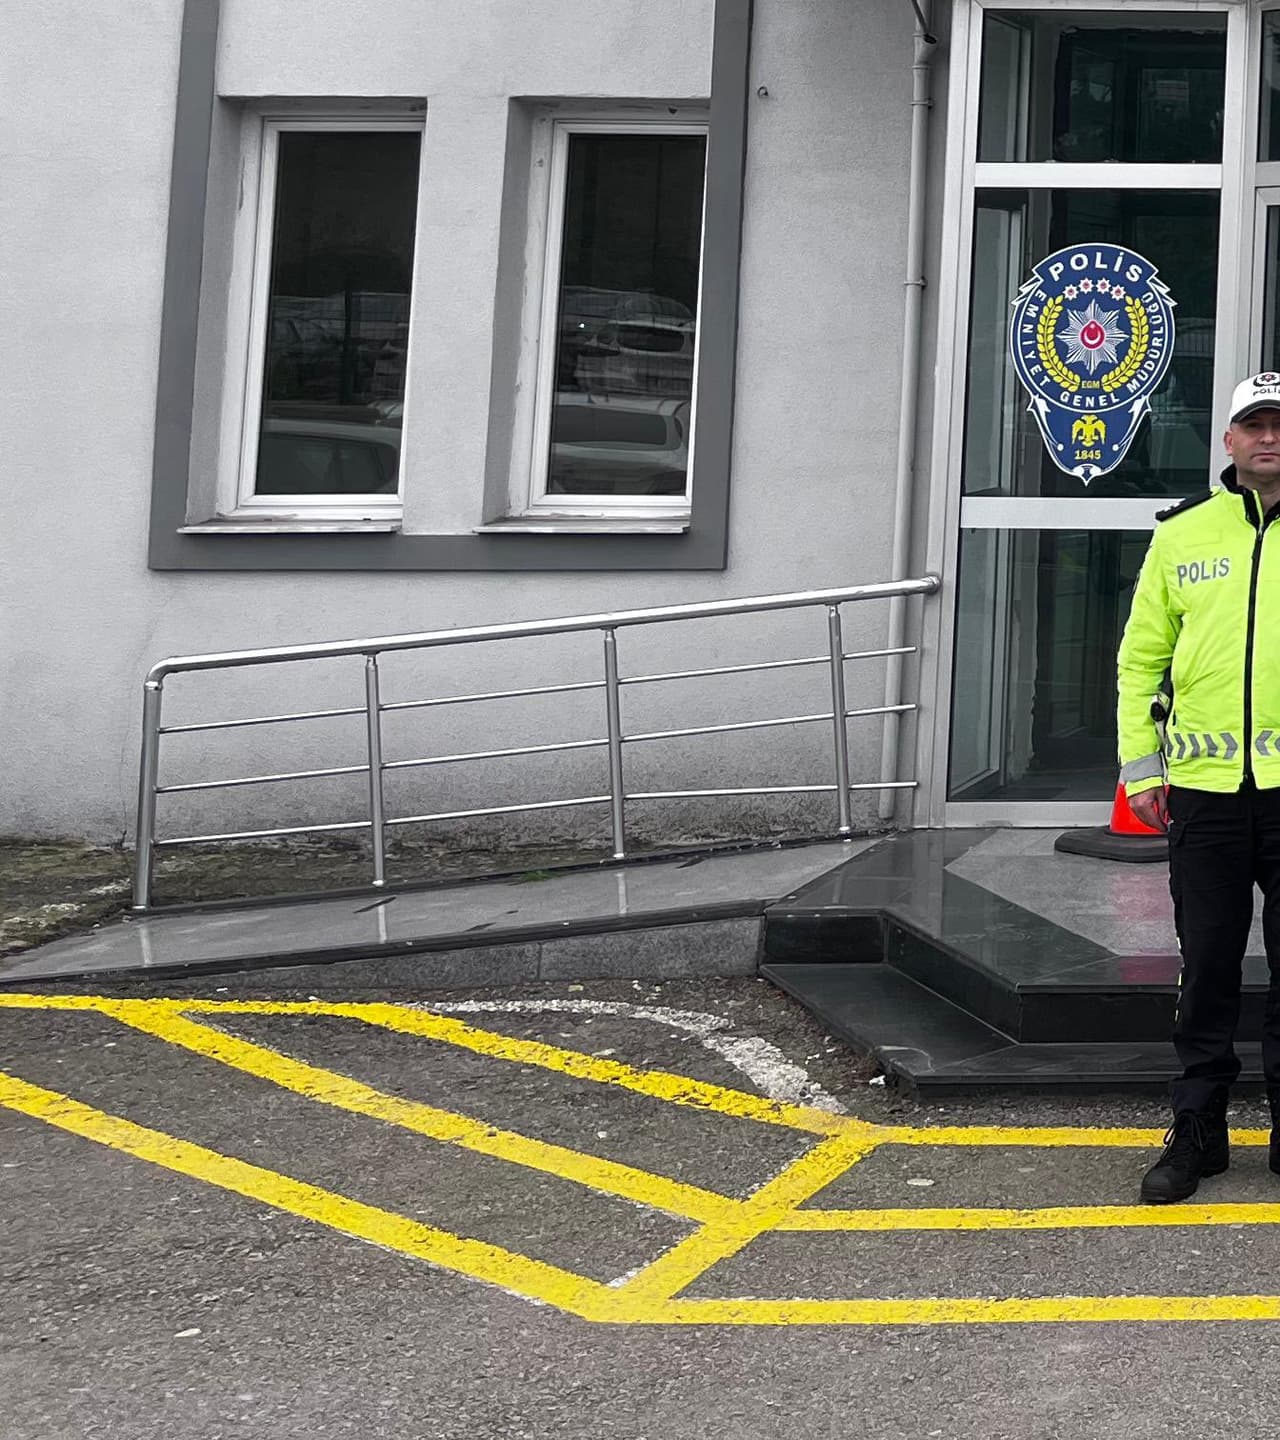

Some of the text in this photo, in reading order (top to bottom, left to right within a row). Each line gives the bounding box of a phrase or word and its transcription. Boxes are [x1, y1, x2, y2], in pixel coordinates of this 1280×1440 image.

[1049, 251, 1143, 283] POLİS
[1059, 392, 1120, 408] GENEL
[1126, 291, 1164, 394] MÜDÜRLÜĞÜ
[1074, 449, 1102, 460] 1845
[1177, 557, 1230, 588] POLİS
